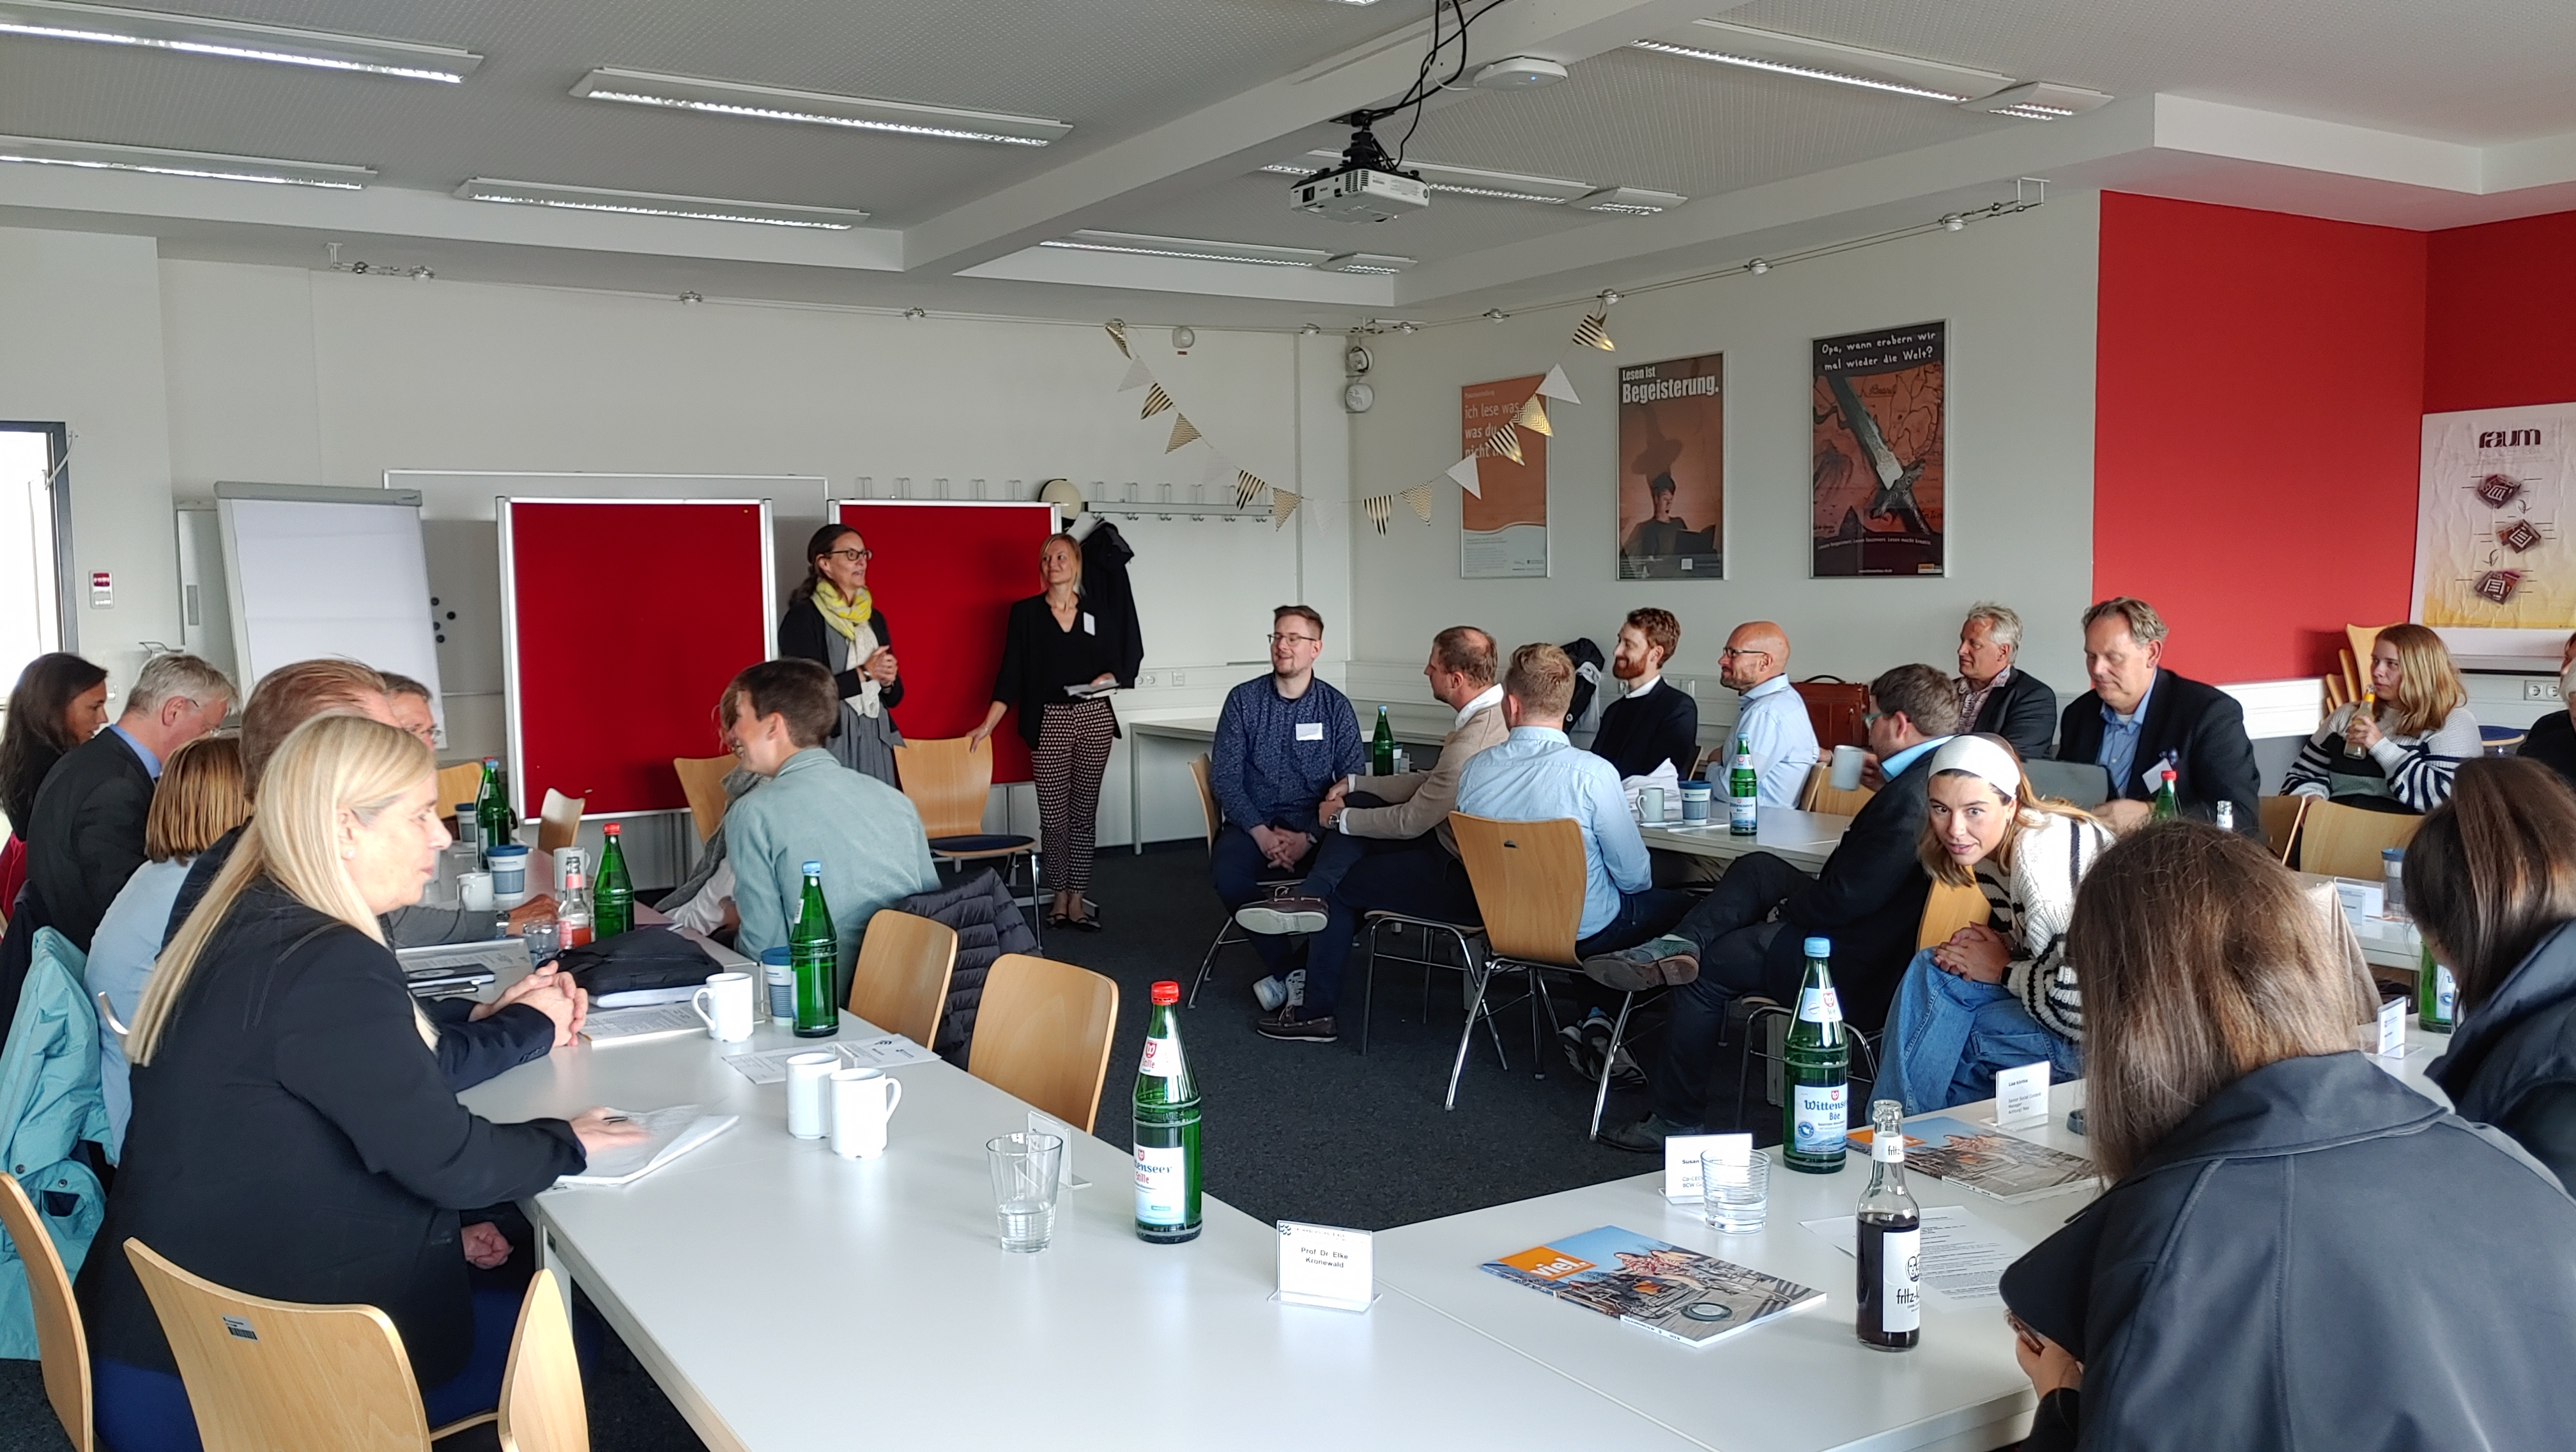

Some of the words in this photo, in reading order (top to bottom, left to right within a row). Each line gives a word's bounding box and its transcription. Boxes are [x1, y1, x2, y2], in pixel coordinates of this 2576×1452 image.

[1821, 343, 1842, 356] Opa,
[1846, 342, 1872, 351] wann
[1876, 334, 1913, 348] erobern
[1917, 332, 1936, 341] wir
[1824, 358, 1842, 371] mal
[1846, 357, 1878, 368] wieder
[1883, 354, 1898, 364] die
[1903, 345, 1933, 360] Welt?
[1622, 369, 1644, 382] Lesen
[1645, 366, 1656, 379] ist
[1622, 375, 1719, 405] Begeisterung.
[1465, 405, 1478, 419] ich
[1482, 403, 1499, 418] lese
[1501, 402, 1519, 414] was
[1464, 427, 1482, 440] was
[1485, 422, 1497, 437] du
[2479, 429, 2541, 449] raum
[1465, 444, 1490, 458] nicht
[1142, 1058, 1155, 1069] Stille
[1829, 1112, 1840, 1120] Böe
[1136, 1171, 1149, 1184] Stille
[1305, 1256, 1344, 1268] Kronewald
[1530, 1256, 1587, 1276] viel.
